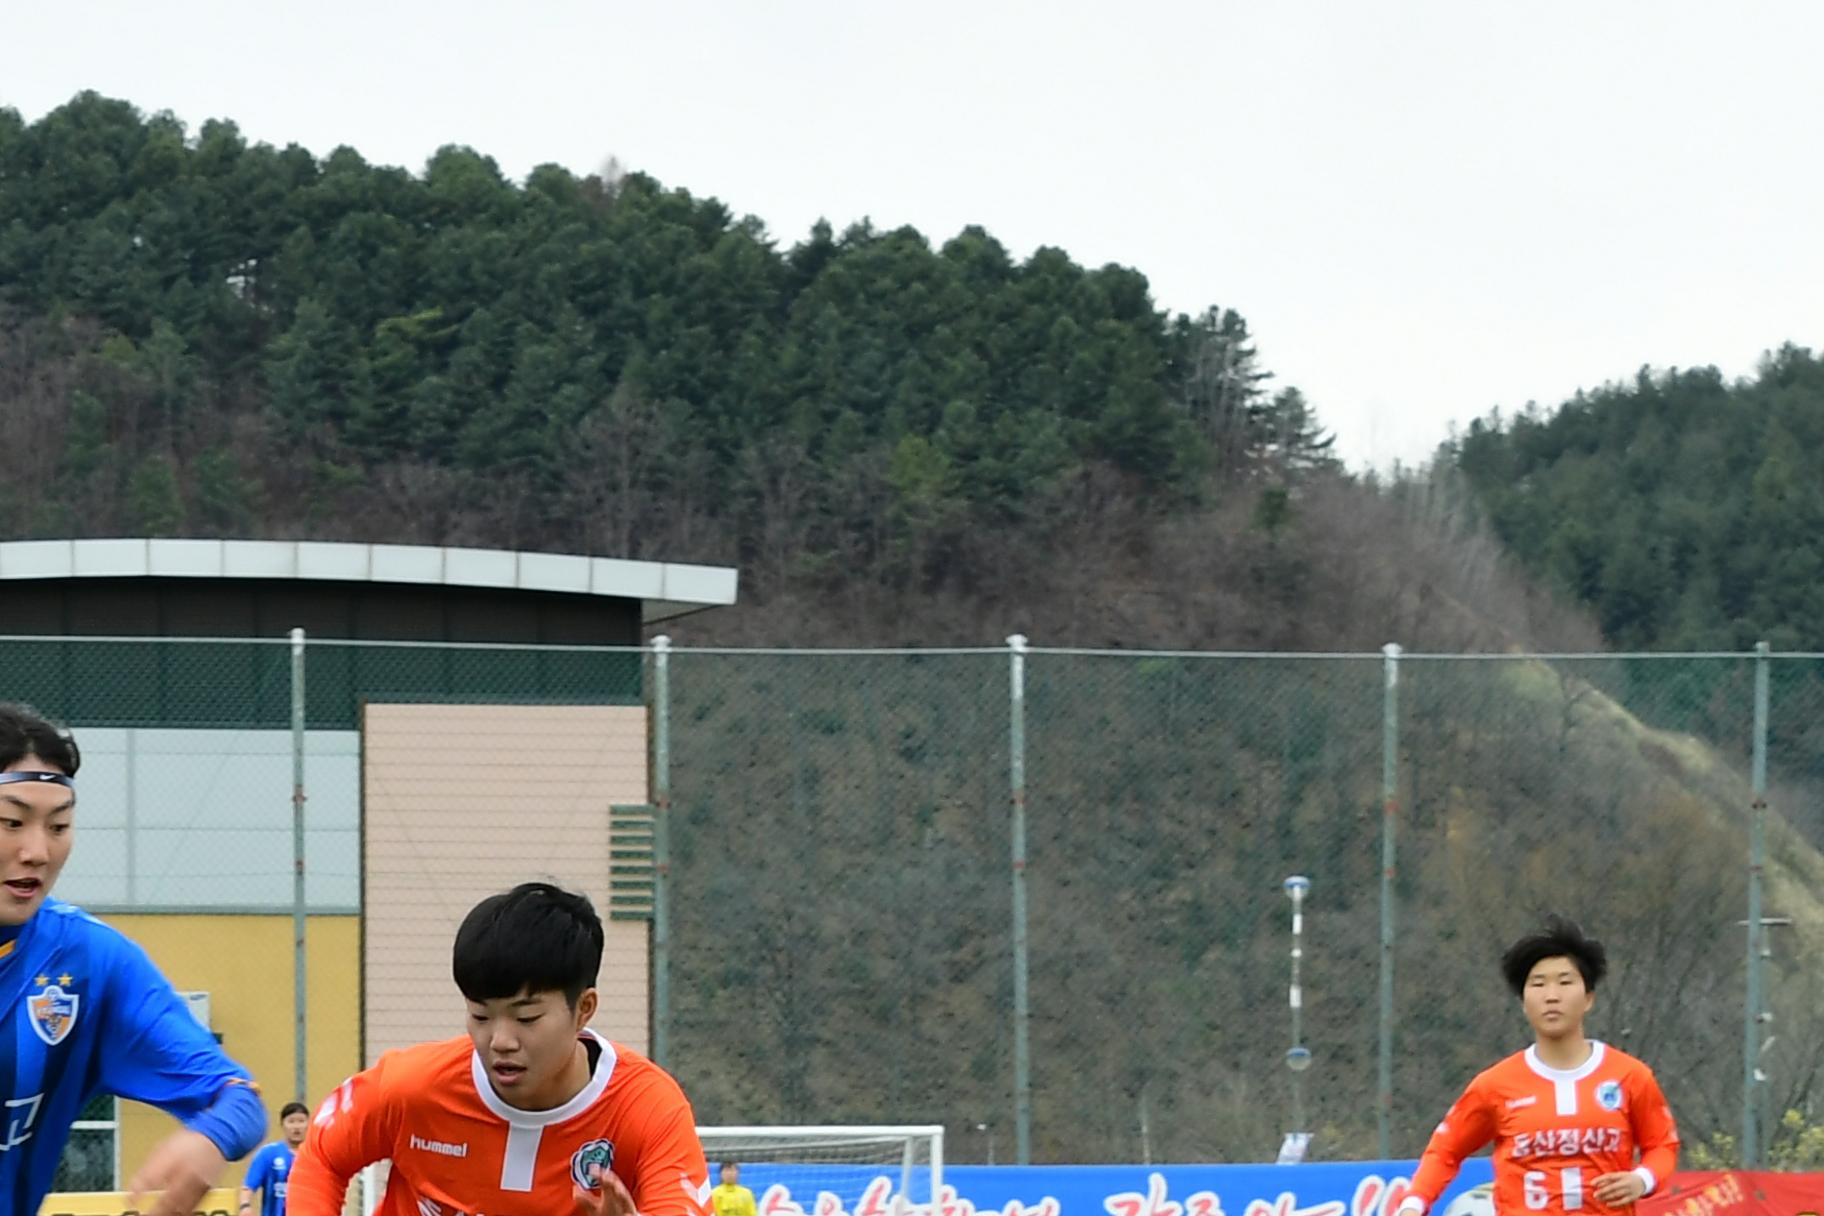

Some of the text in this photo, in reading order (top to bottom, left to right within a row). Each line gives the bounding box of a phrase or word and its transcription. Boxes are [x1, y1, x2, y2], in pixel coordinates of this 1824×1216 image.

[410, 1134, 468, 1157] hummel
[1511, 1128, 1620, 1157] 동산정산고
[1523, 1170, 1549, 1211] 6
